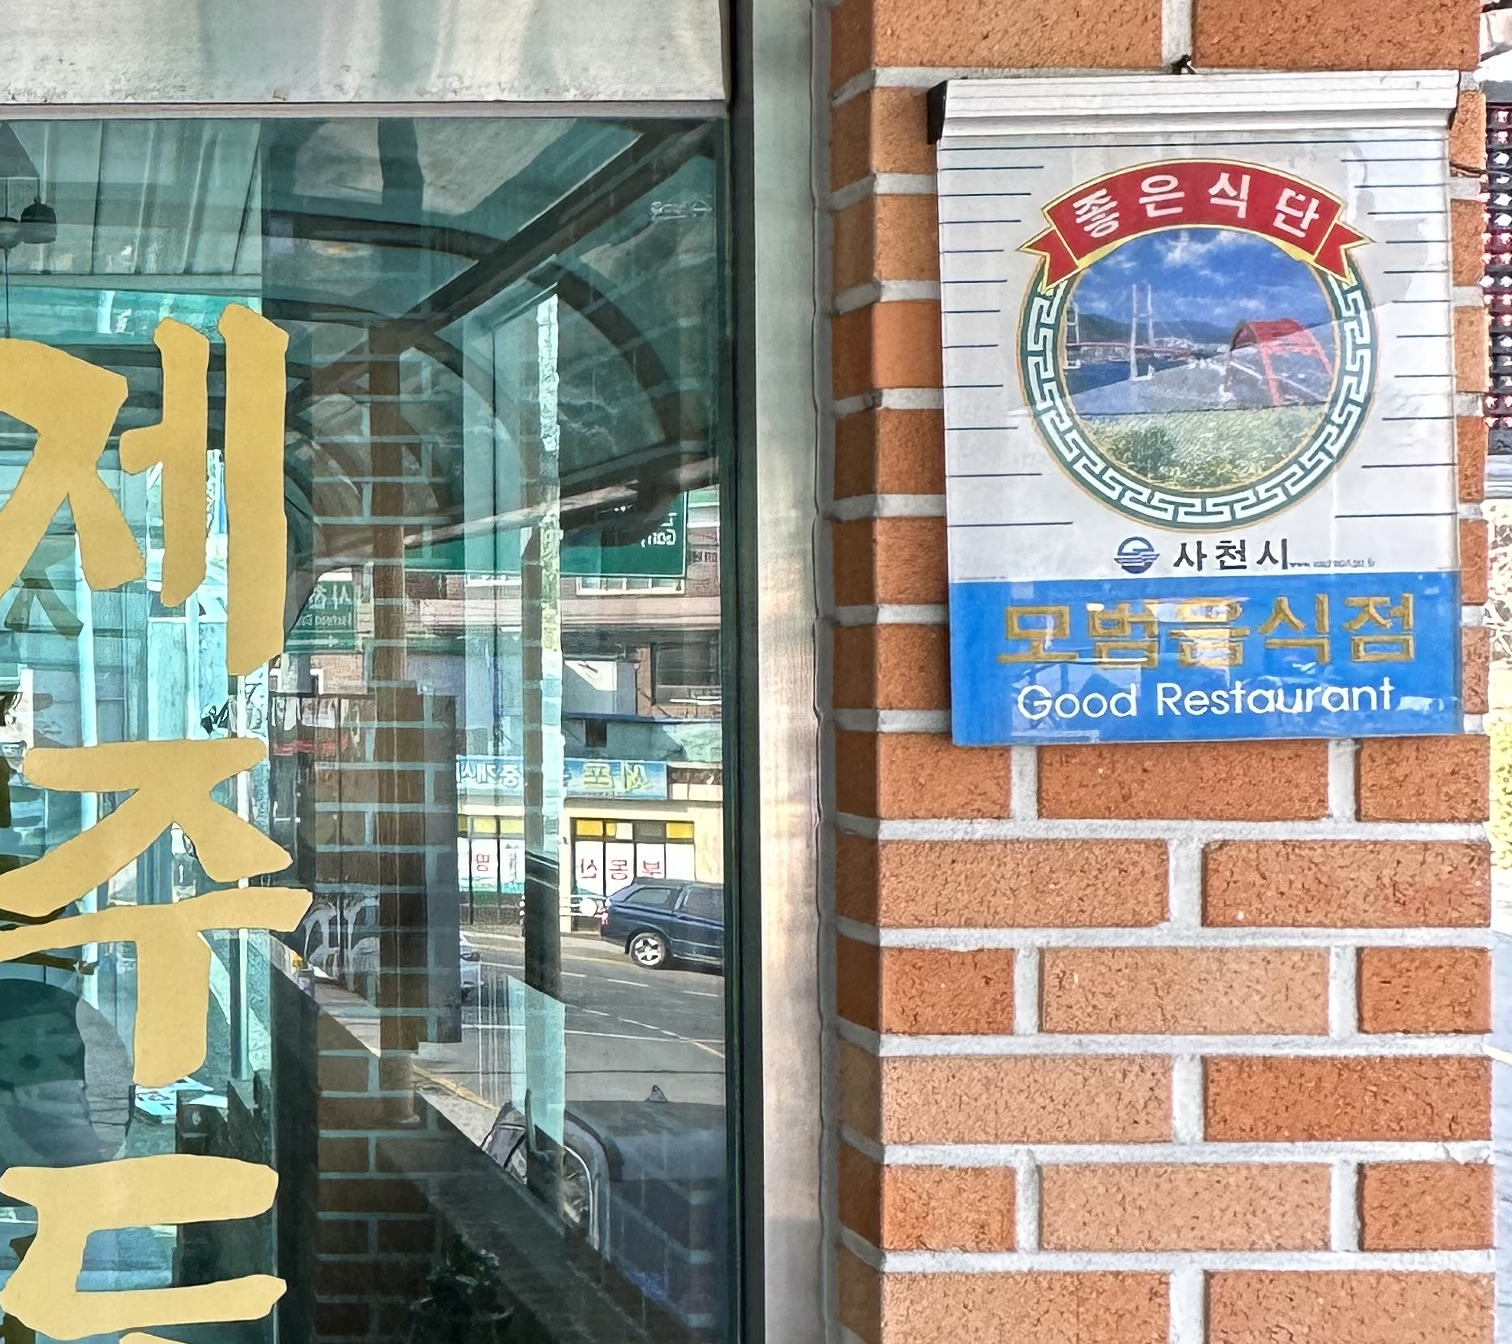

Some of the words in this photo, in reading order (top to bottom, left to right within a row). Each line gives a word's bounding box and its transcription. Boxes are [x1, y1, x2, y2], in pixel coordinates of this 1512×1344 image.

[1174, 538, 1288, 573] 사천시
[999, 593, 1416, 670] 모범음식점
[1017, 683, 1138, 720] Good
[1157, 677, 1395, 717] Restaurant
